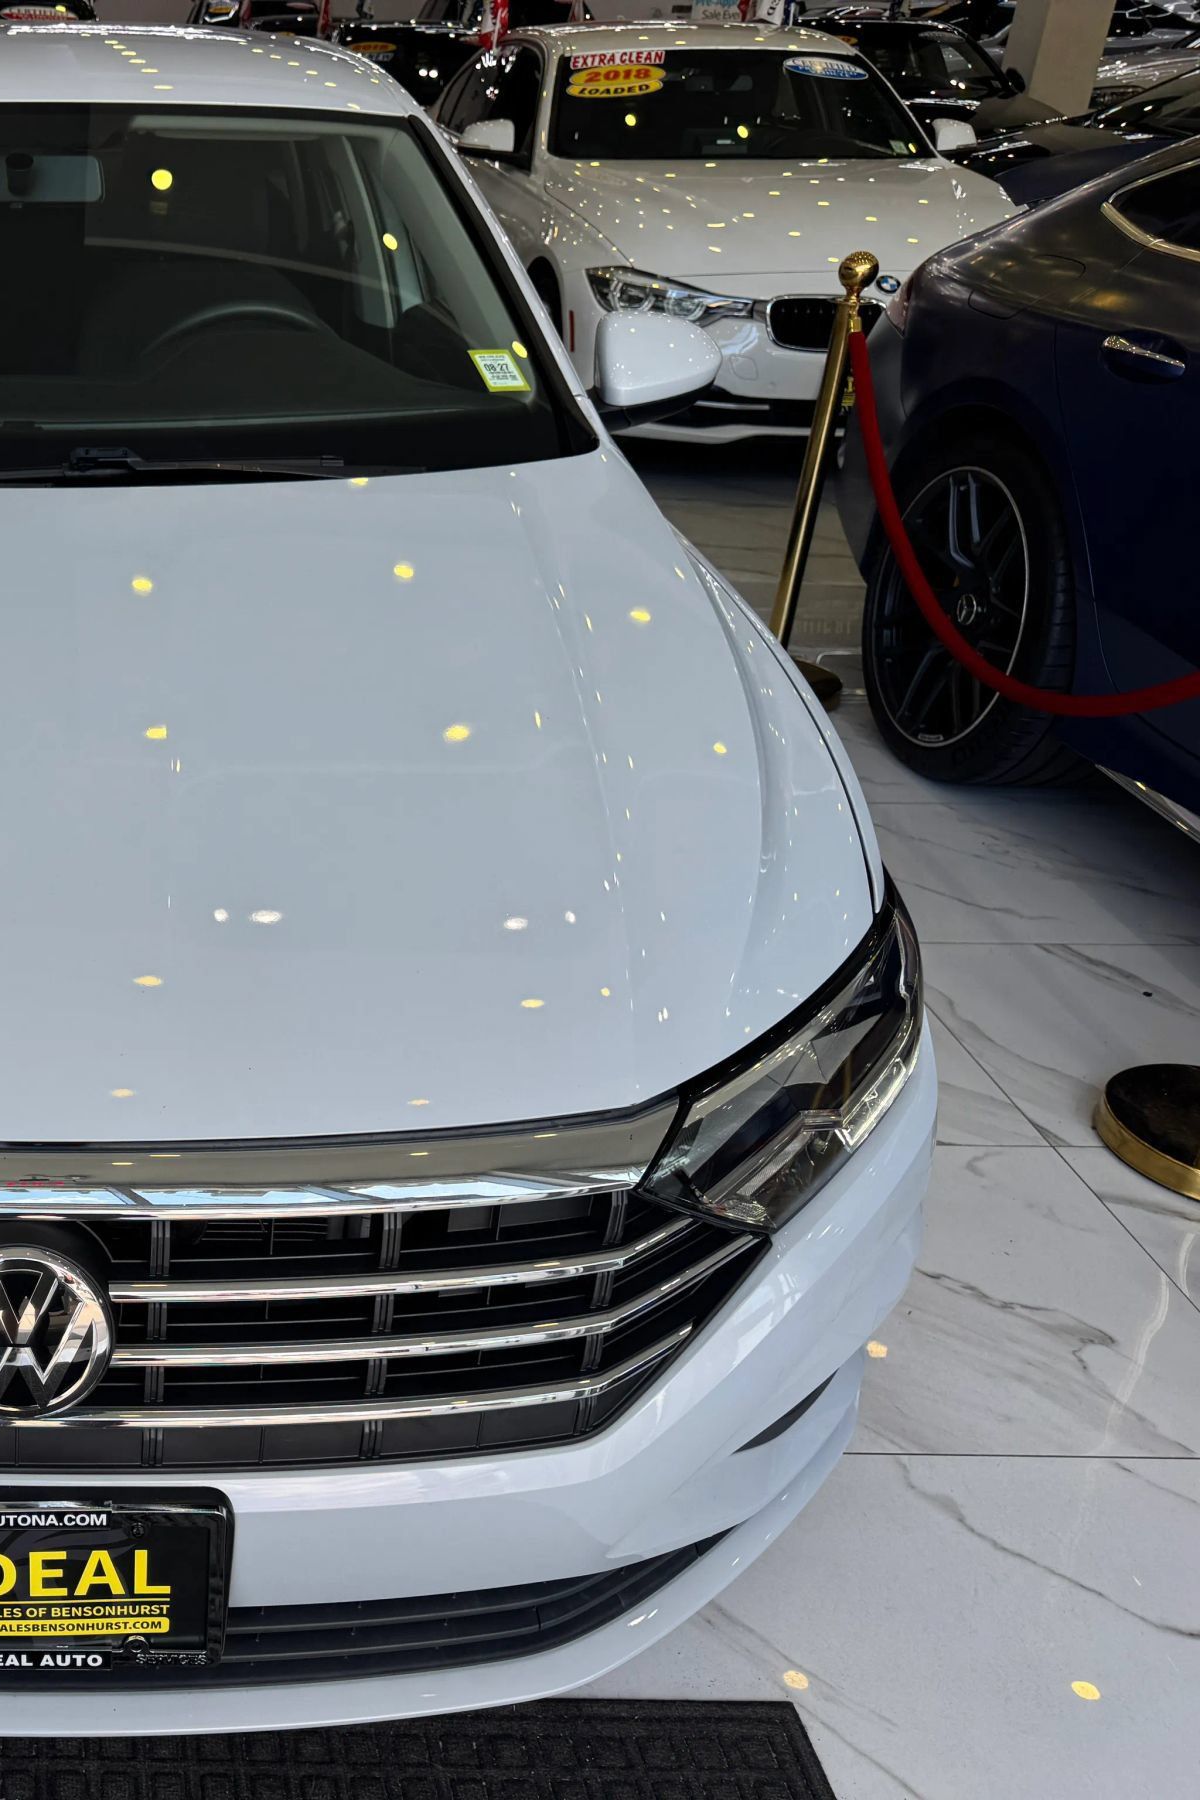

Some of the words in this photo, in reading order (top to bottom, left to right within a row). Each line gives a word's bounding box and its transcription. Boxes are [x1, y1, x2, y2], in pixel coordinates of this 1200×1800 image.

[571, 53, 616, 69] EXTRA
[619, 51, 664, 65] CLEAN
[584, 68, 652, 84] 2018
[578, 83, 651, 96] LOADED
[26, 1606, 47, 1618] OF
[51, 1604, 170, 1617] BENSONHURST
[39, 1654, 103, 1667] AUTO
